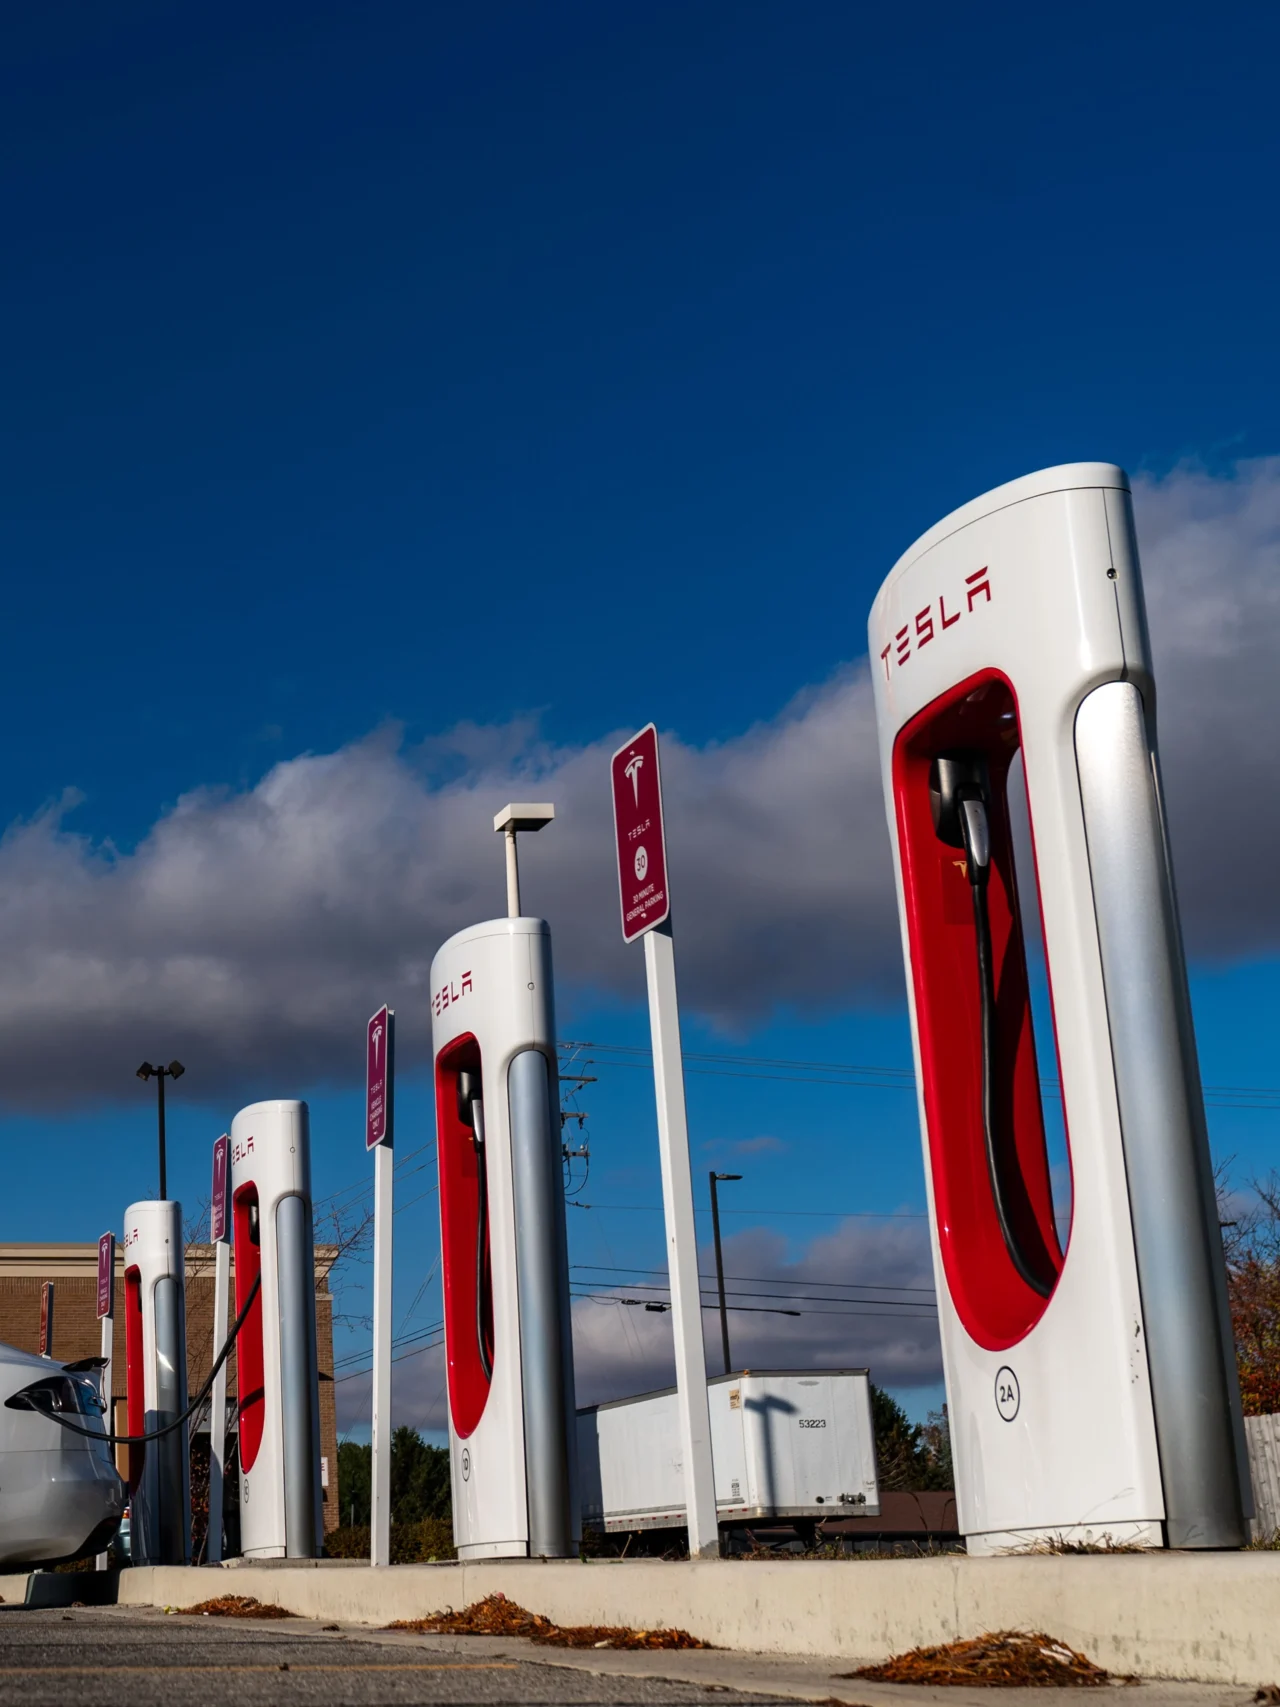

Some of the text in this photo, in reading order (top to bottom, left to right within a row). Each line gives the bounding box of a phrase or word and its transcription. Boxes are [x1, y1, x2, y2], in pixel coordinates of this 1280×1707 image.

[880, 565, 991, 681] TESLA
[627, 818, 651, 841] TESLA
[636, 854, 646, 872] 30
[638, 883, 655, 901] MINUTE
[626, 890, 664, 922] GENERAL PARKING
[232, 1136, 254, 1166] ESLA
[1000, 1384, 1015, 1402] 2A
[799, 1419, 826, 1428] 53223
